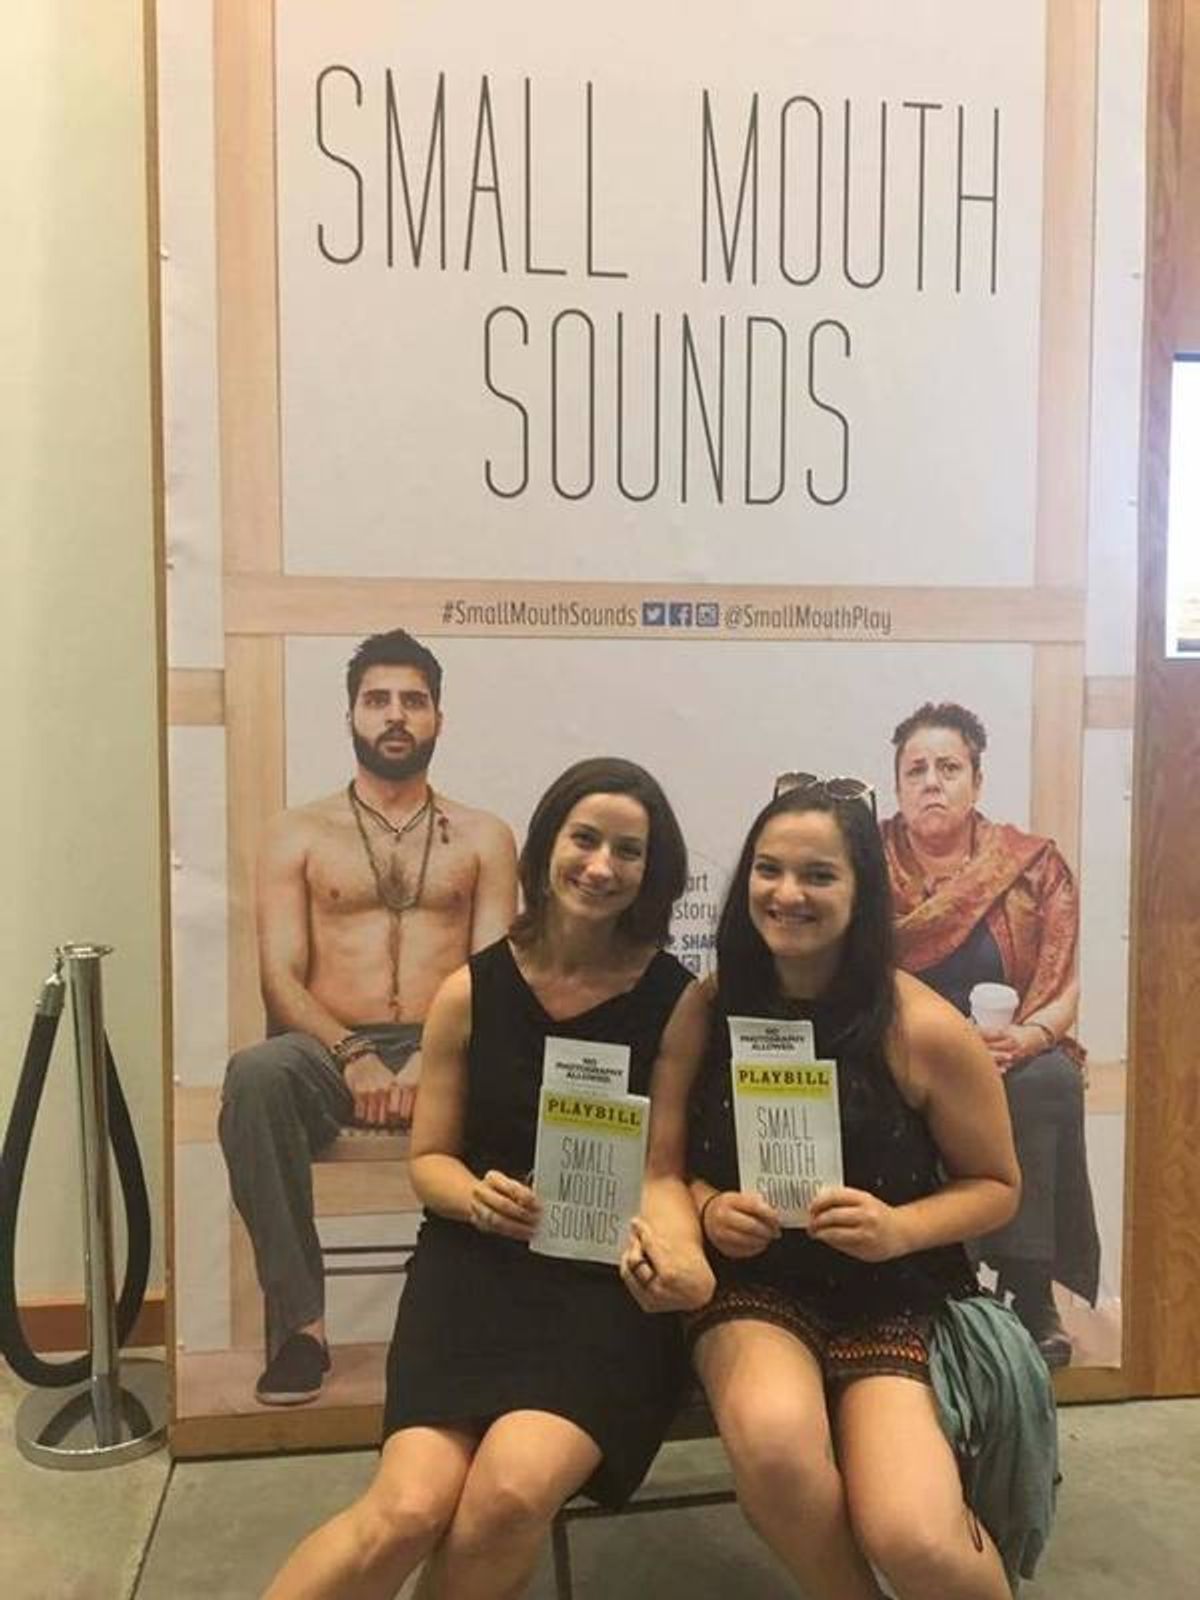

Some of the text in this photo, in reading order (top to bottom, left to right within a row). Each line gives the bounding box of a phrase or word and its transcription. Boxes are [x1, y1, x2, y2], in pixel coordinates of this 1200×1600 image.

[315, 65, 1000, 295] SMALL MOUTH
[484, 305, 852, 506] SOUNDS
[441, 602, 637, 627] #SmallMouthSounds
[724, 604, 892, 634] @SmallMouthPlay
[738, 1069, 830, 1086] PLAYBILL
[548, 1098, 641, 1127] PLAYBILL
[756, 1106, 813, 1141] SMALL
[560, 1136, 616, 1175] SMALL
[758, 1142, 816, 1176] MOUTH
[558, 1173, 618, 1209] MOUTH
[549, 1204, 621, 1246] SOUNDS
